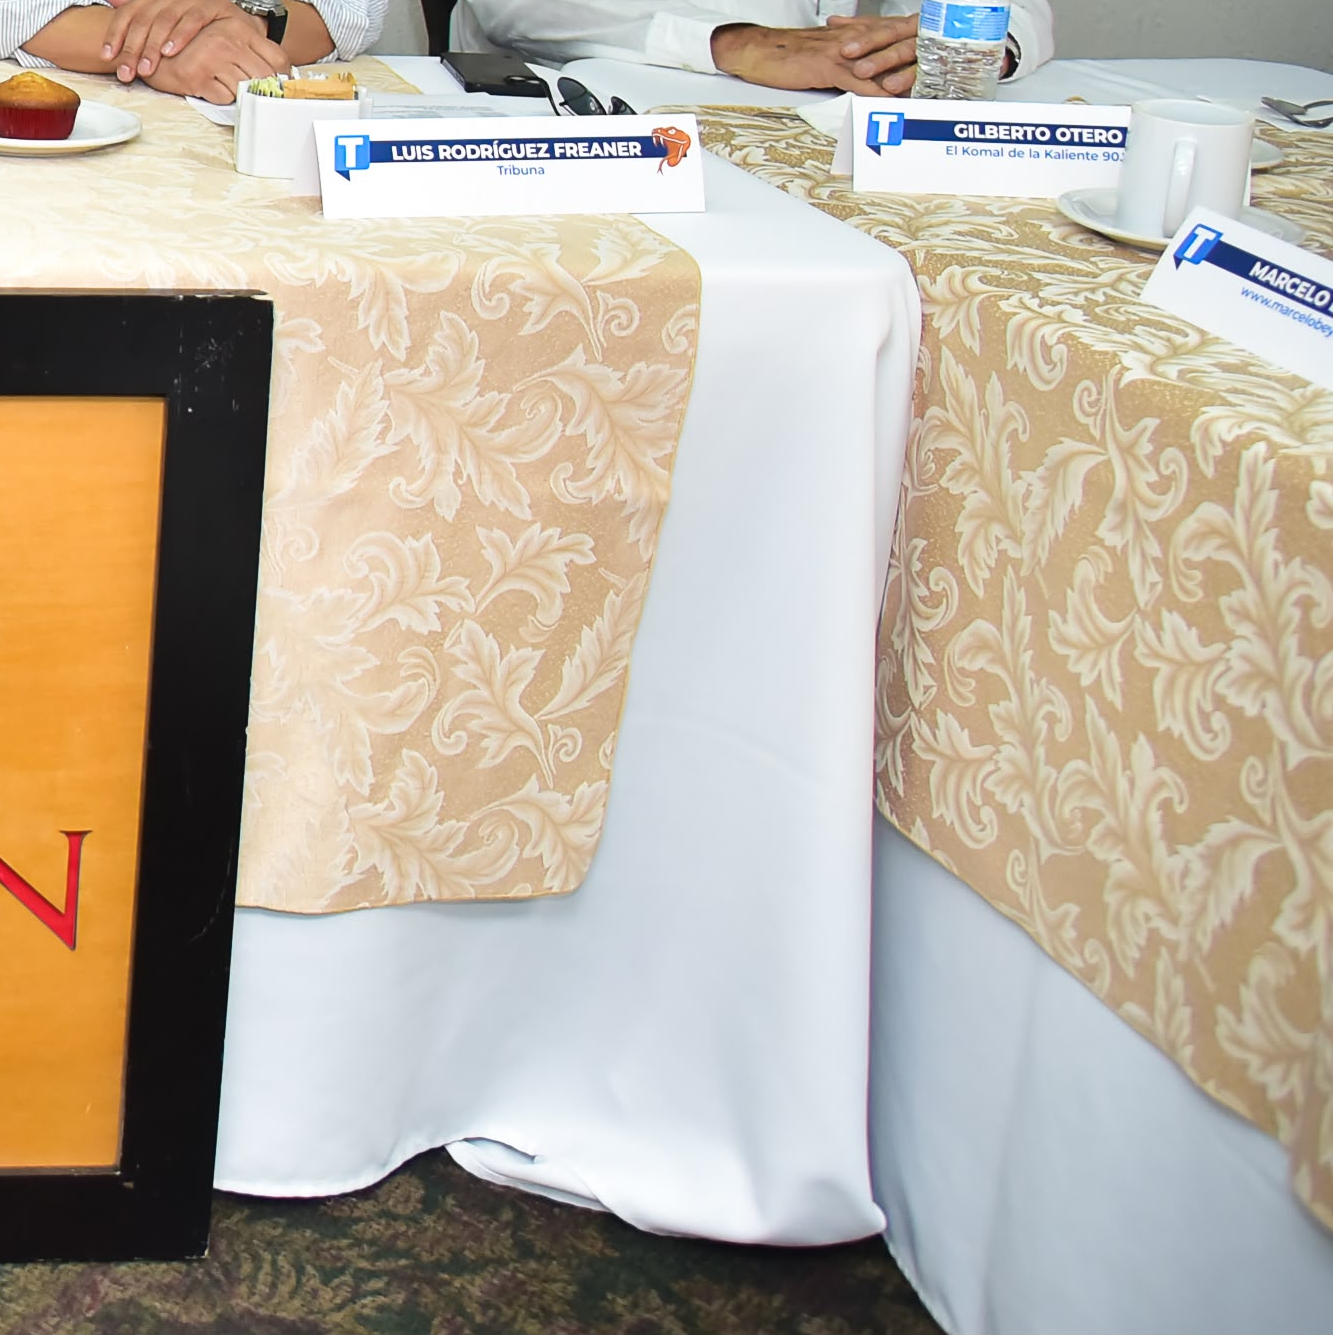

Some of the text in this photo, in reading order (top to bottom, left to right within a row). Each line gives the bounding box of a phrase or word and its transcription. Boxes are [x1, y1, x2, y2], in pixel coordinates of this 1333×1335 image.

[953, 123, 1123, 144] GILBERTO OTERO
[391, 140, 643, 161] LUIS RODRÍGUEZ FREANER
[945, 145, 958, 156] El
[962, 146, 1005, 158] Komal
[1008, 147, 1025, 159] de
[1028, 149, 1041, 160] la
[1044, 148, 1099, 162] Kaliente
[496, 164, 546, 176] Tribuna
[1248, 260, 1331, 308] MARCELO
